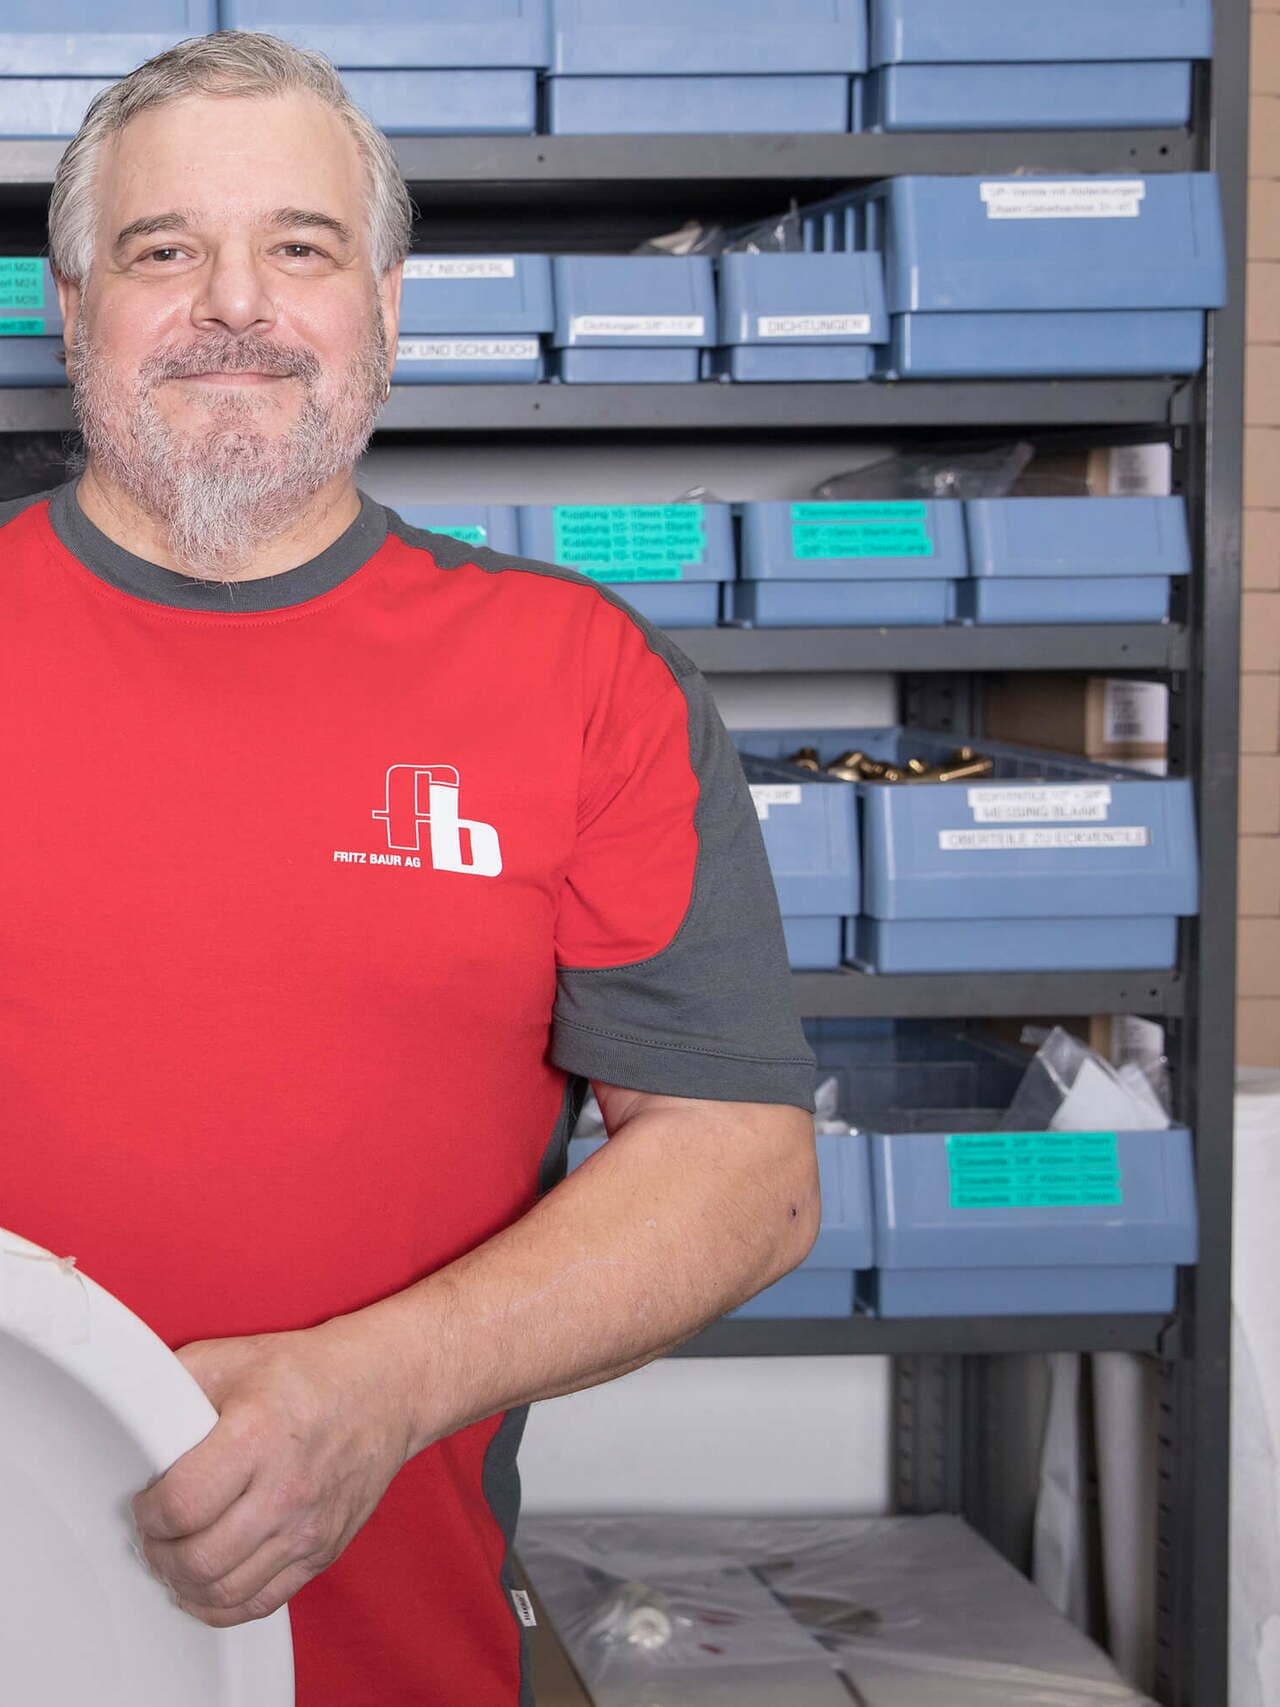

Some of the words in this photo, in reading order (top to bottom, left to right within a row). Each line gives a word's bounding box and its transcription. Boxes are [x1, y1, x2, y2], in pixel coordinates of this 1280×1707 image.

[438, 262, 505, 275] NEOPERL
[767, 319, 865, 333] DICHTUNGEN
[419, 344, 453, 357] UND
[455, 344, 534, 357] SCHLAUCH
[333, 850, 366, 864] FRITZ
[370, 853, 402, 867] BAUR
[404, 856, 421, 868] AG
